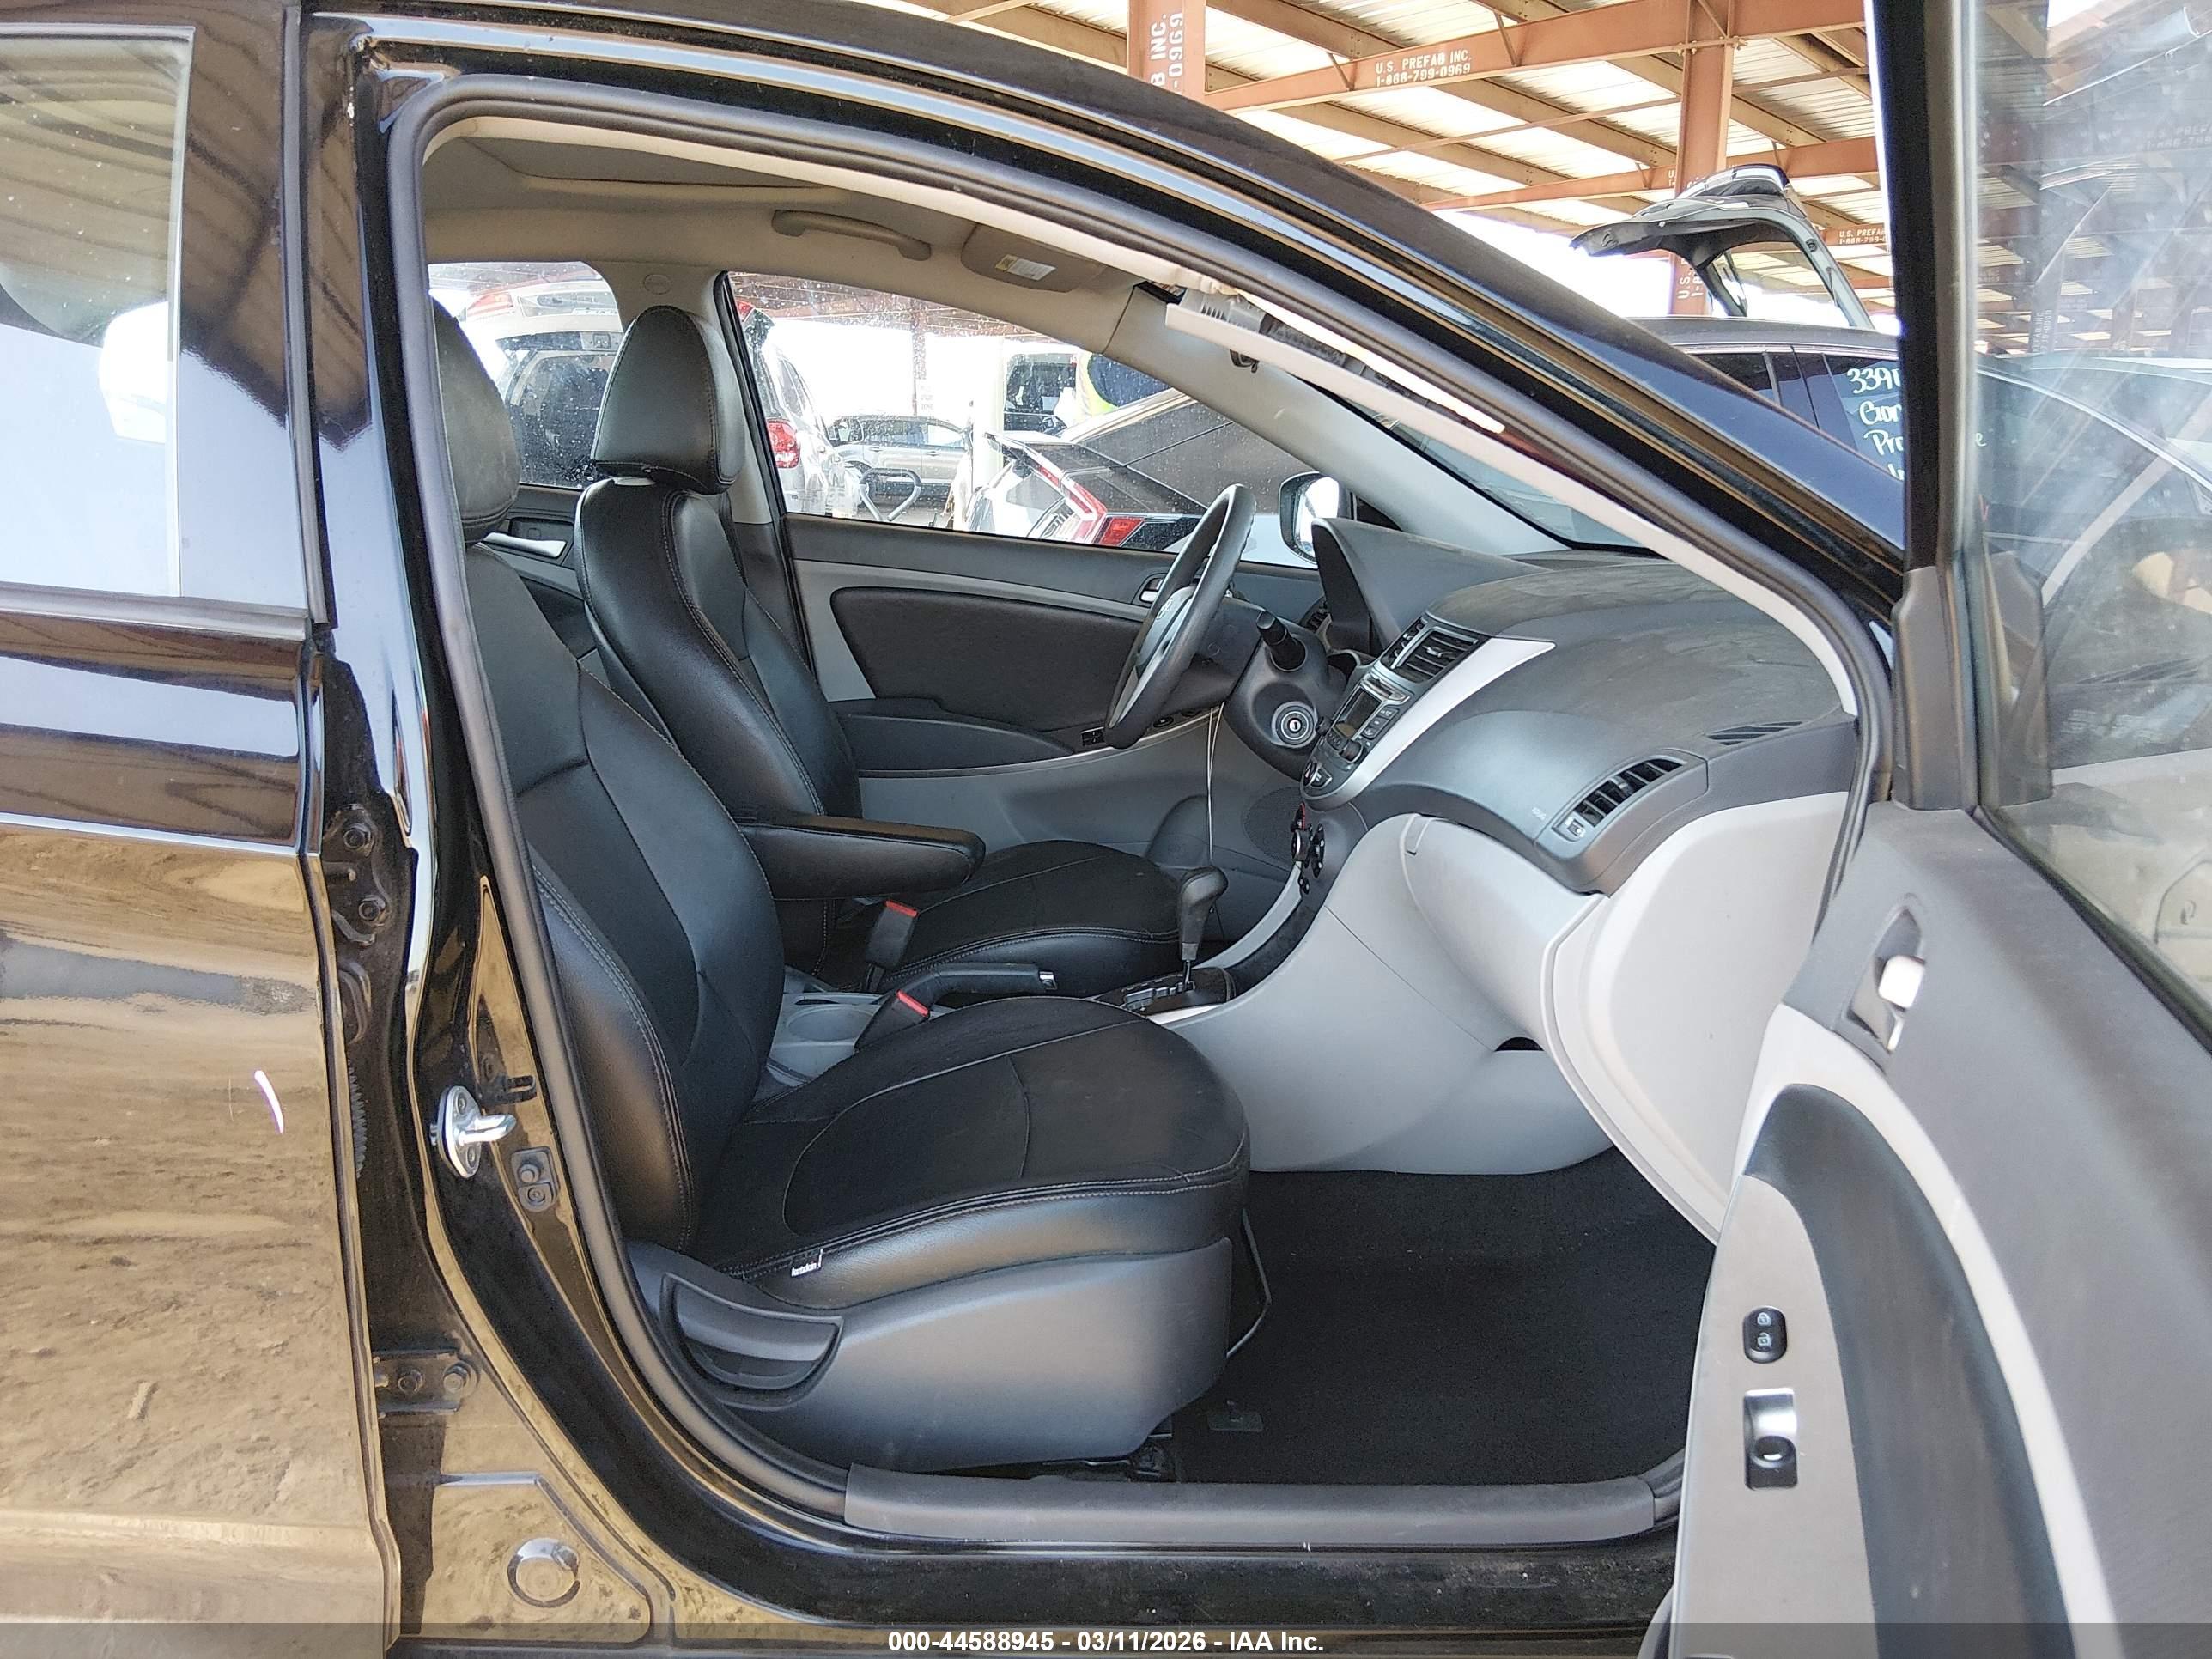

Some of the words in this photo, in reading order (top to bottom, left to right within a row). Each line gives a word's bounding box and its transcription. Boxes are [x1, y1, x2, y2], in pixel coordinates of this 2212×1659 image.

[1150, 14, 1168, 61] INC.
[1376, 60, 1397, 75] U.S.
[1401, 52, 1446, 71] PREFAB
[1449, 49, 1473, 64] INC.
